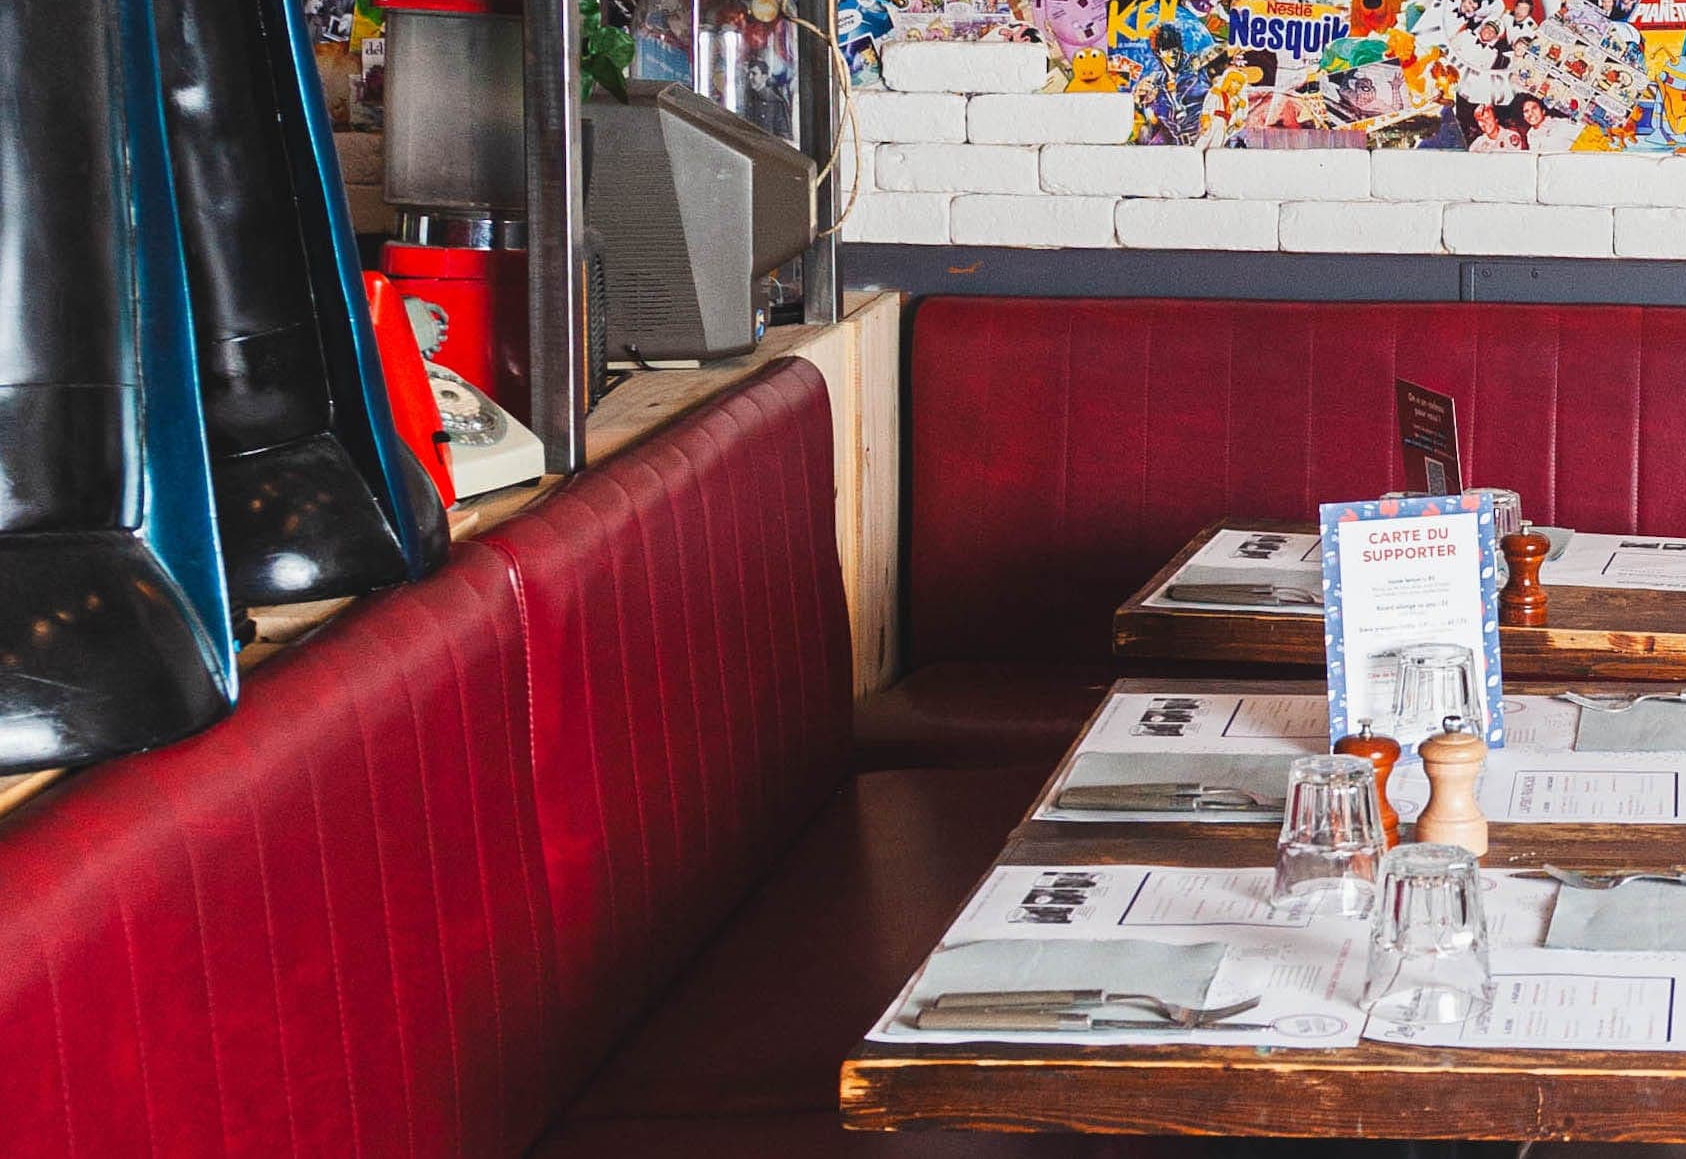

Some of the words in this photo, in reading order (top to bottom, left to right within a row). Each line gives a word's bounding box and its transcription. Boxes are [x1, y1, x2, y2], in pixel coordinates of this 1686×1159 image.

[1368, 529, 1422, 545] CARTE
[1426, 527, 1450, 541] DU
[1362, 544, 1457, 563] SUPPORTER
